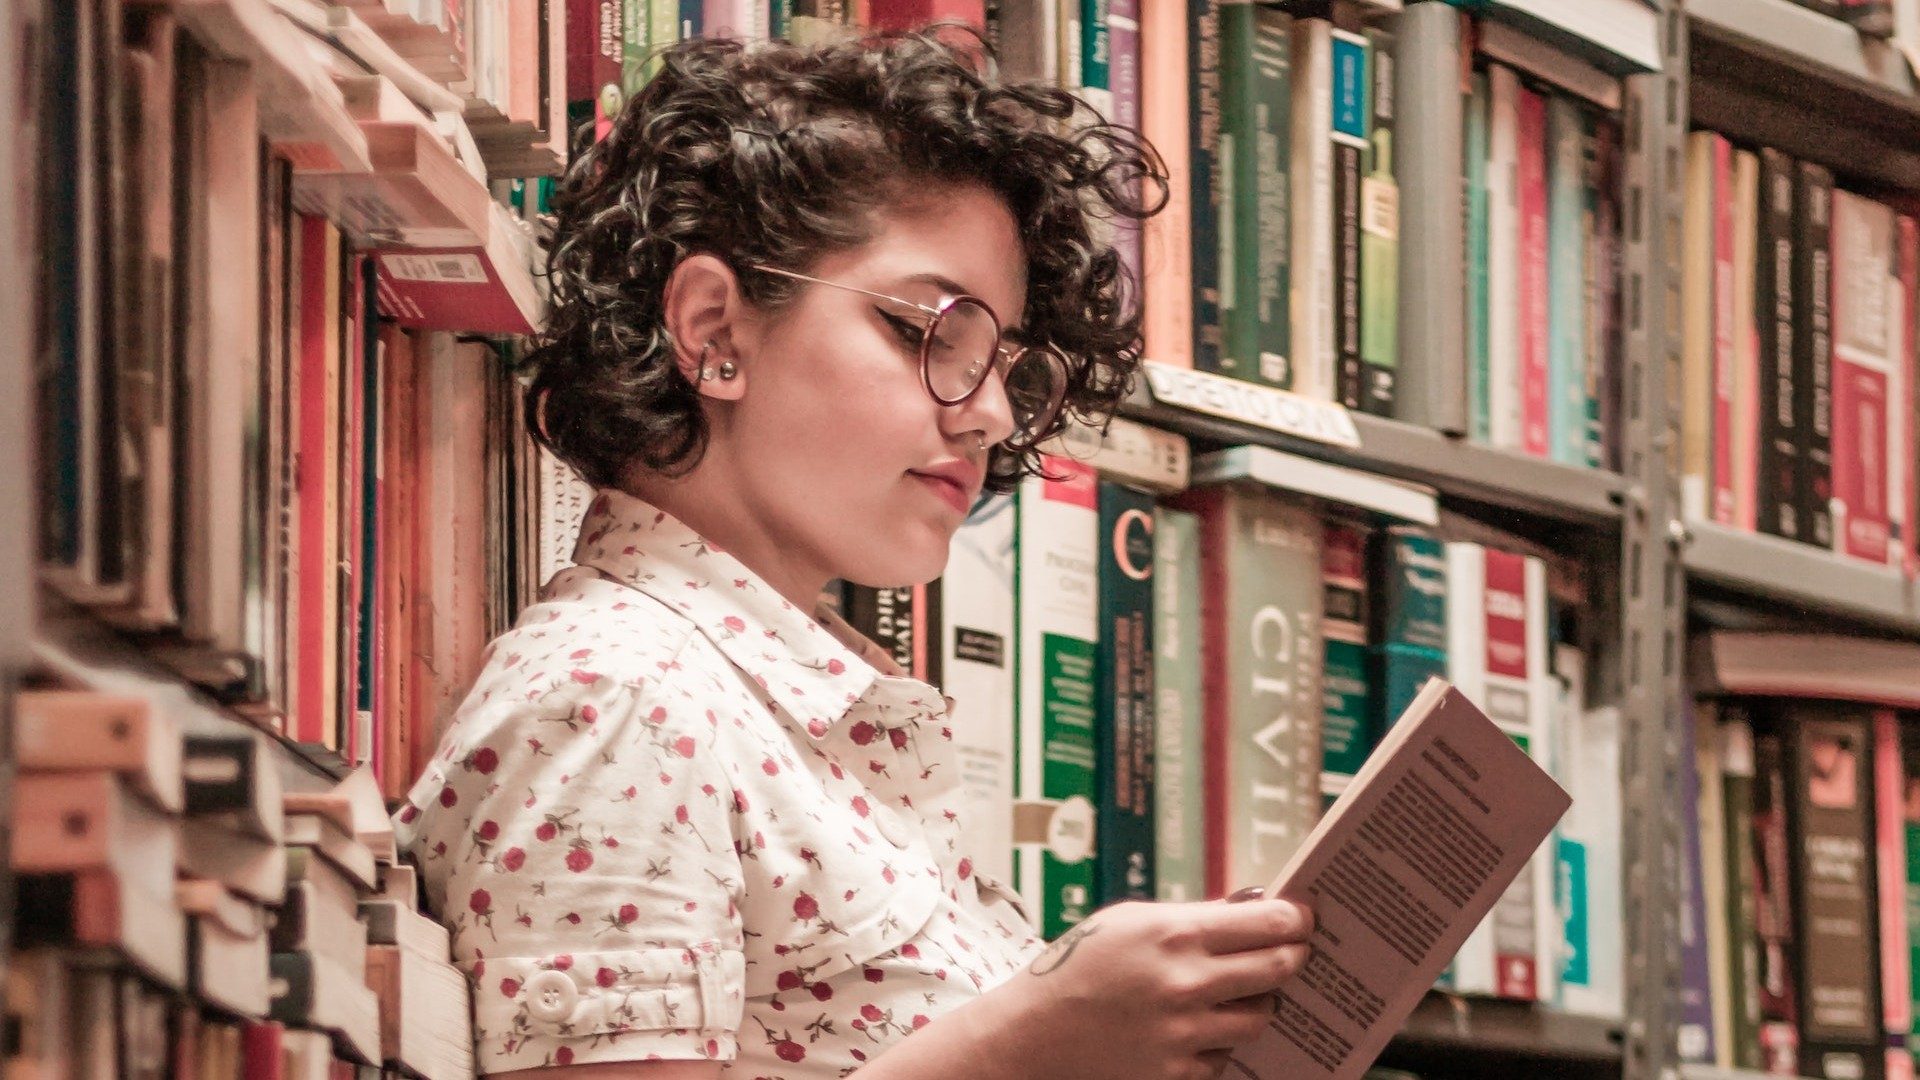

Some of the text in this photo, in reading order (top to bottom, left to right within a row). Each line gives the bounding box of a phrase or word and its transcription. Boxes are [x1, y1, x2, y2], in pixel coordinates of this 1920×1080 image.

[1150, 365, 1352, 440] DIREITO CIVIL
[554, 462, 566, 564] ROCESS
[878, 588, 893, 637] DIR
[1250, 607, 1292, 865] CIVIL
